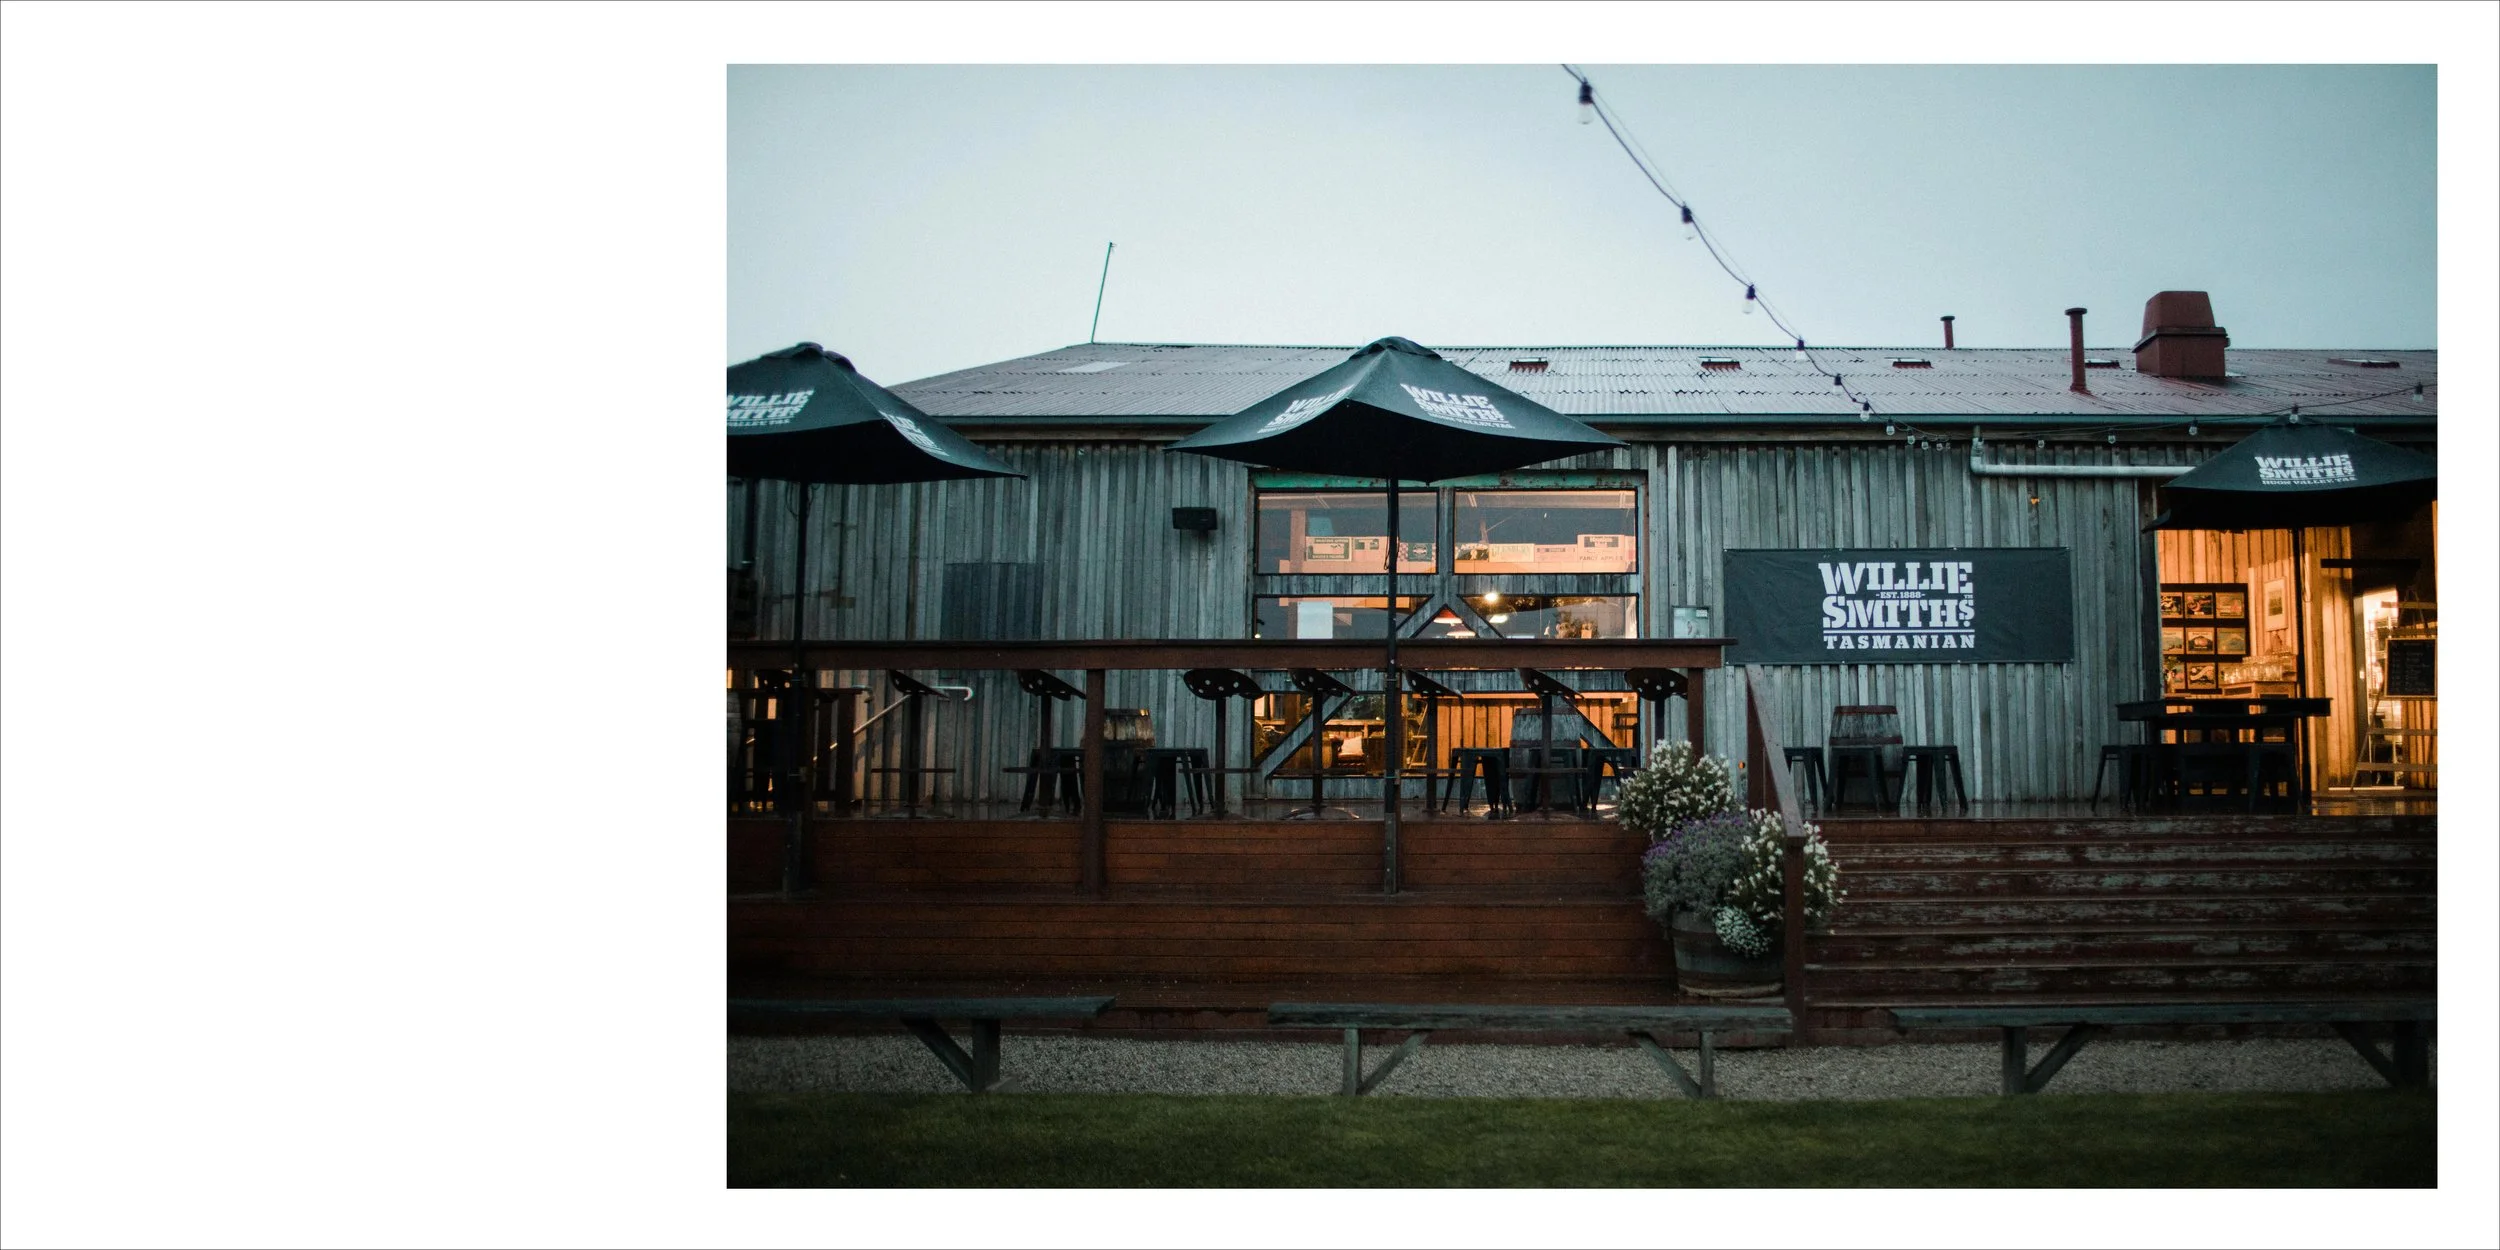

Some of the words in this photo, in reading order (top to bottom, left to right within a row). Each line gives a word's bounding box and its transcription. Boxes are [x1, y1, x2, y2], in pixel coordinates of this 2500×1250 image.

[1400, 383, 1490, 407] WILLIE
[2255, 454, 2352, 469] WILLIE
[1818, 562, 1973, 595] WILLIE
[1824, 635, 1975, 649] TASMANIAN
